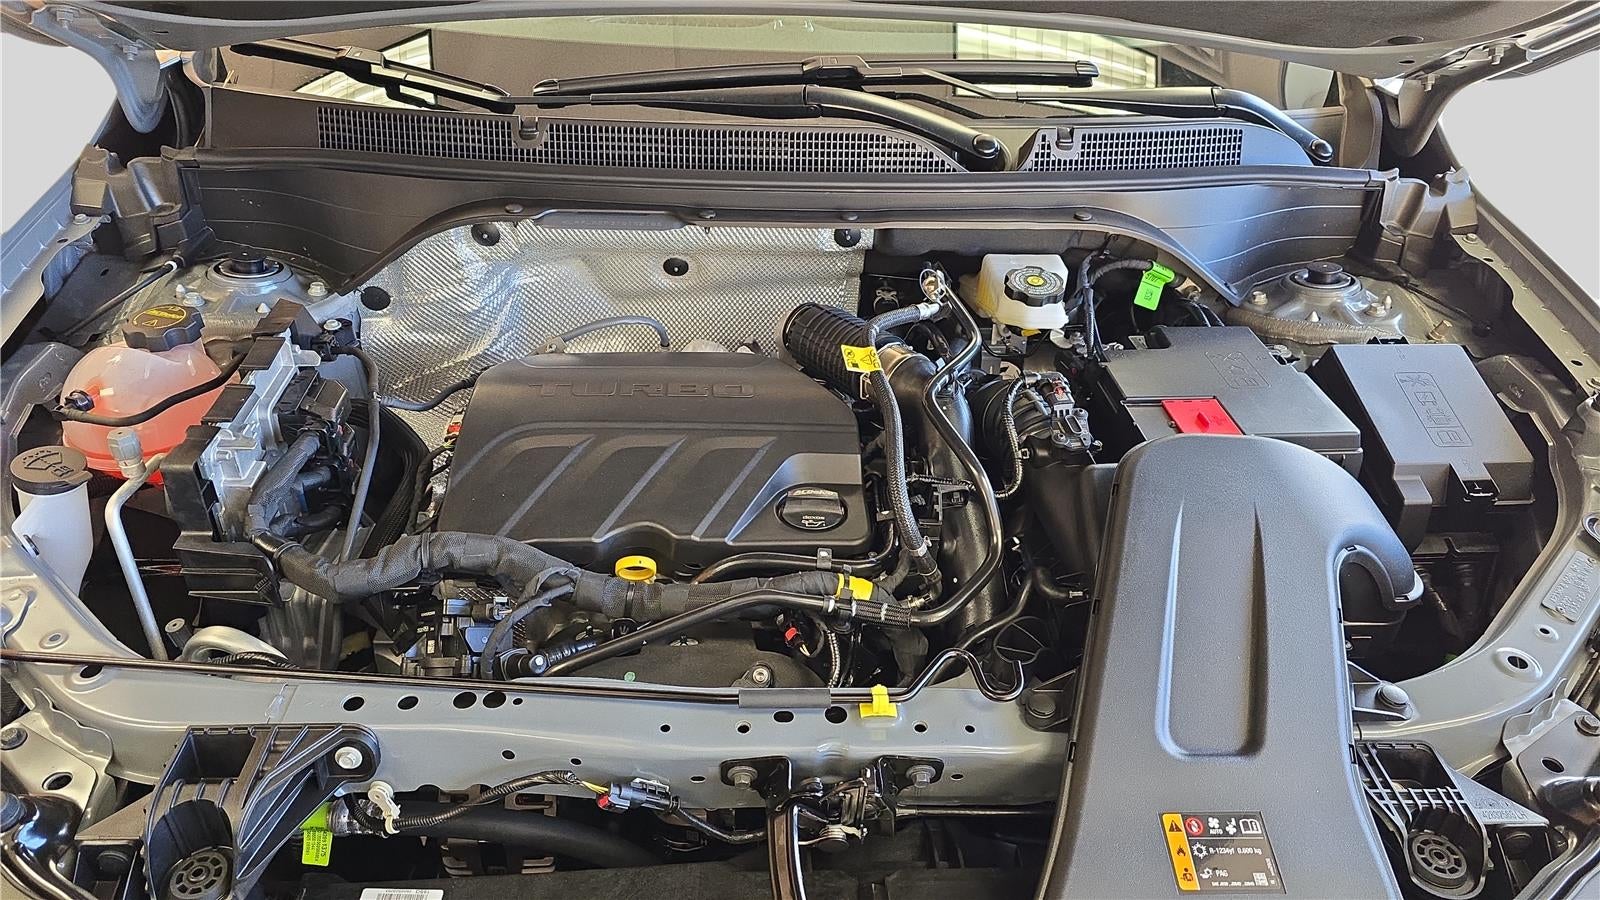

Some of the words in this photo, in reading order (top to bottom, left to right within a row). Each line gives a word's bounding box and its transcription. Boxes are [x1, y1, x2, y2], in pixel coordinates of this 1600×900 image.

[528, 383, 756, 399] TURBO
[1254, 847, 1262, 855] kg
[1215, 869, 1229, 877] PAG
